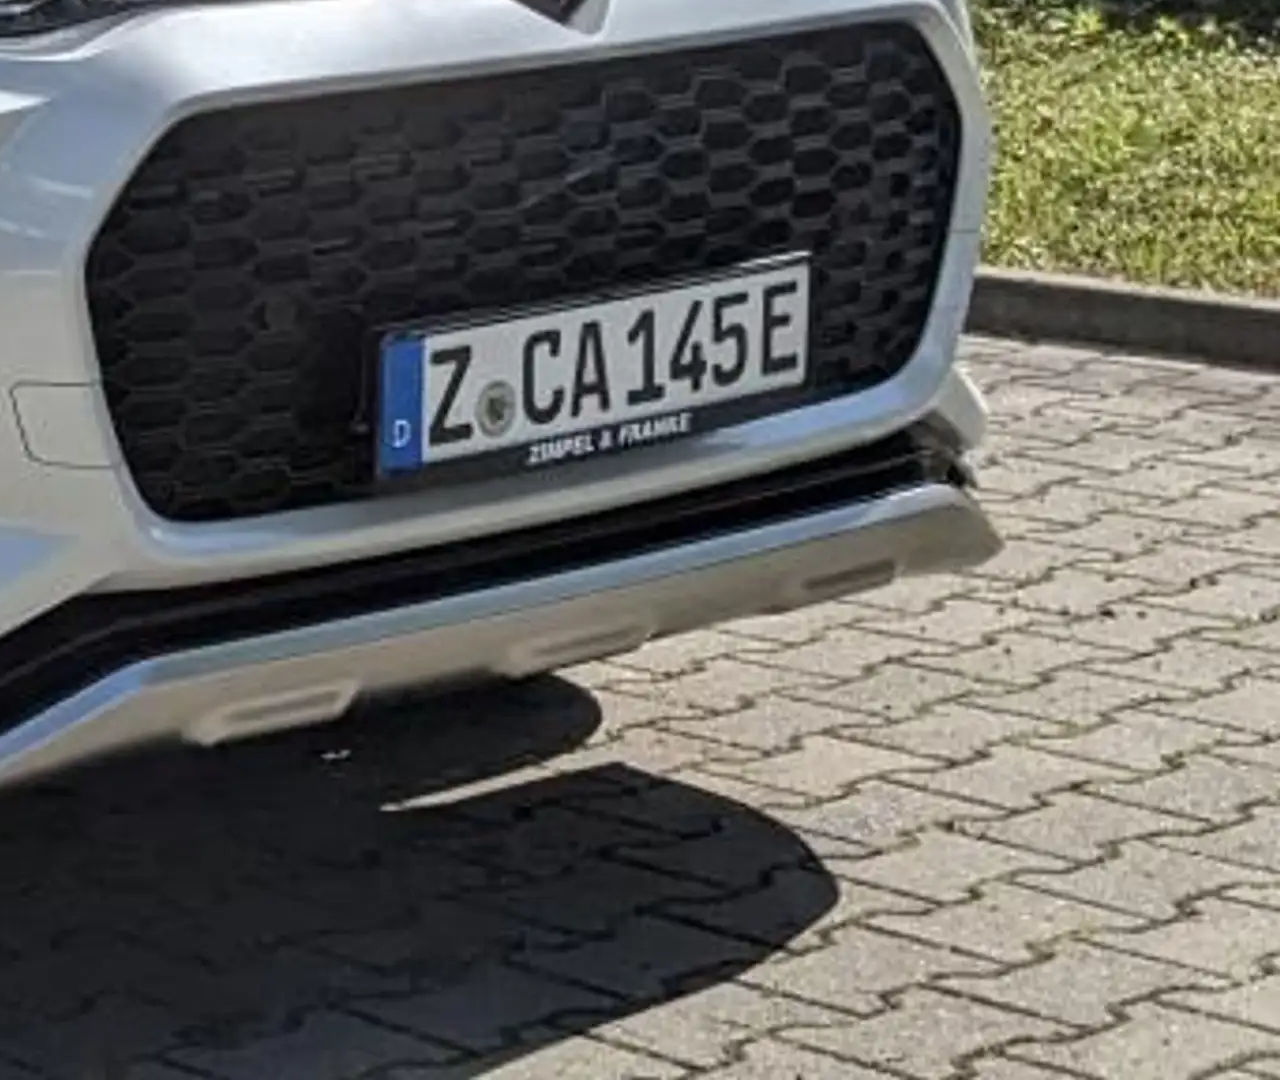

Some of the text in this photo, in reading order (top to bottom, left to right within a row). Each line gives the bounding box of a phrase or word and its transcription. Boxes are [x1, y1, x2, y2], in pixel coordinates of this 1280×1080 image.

[429, 345, 474, 447] Z
[526, 431, 595, 467] ZIMPEL
[618, 412, 693, 446] FRANKE
